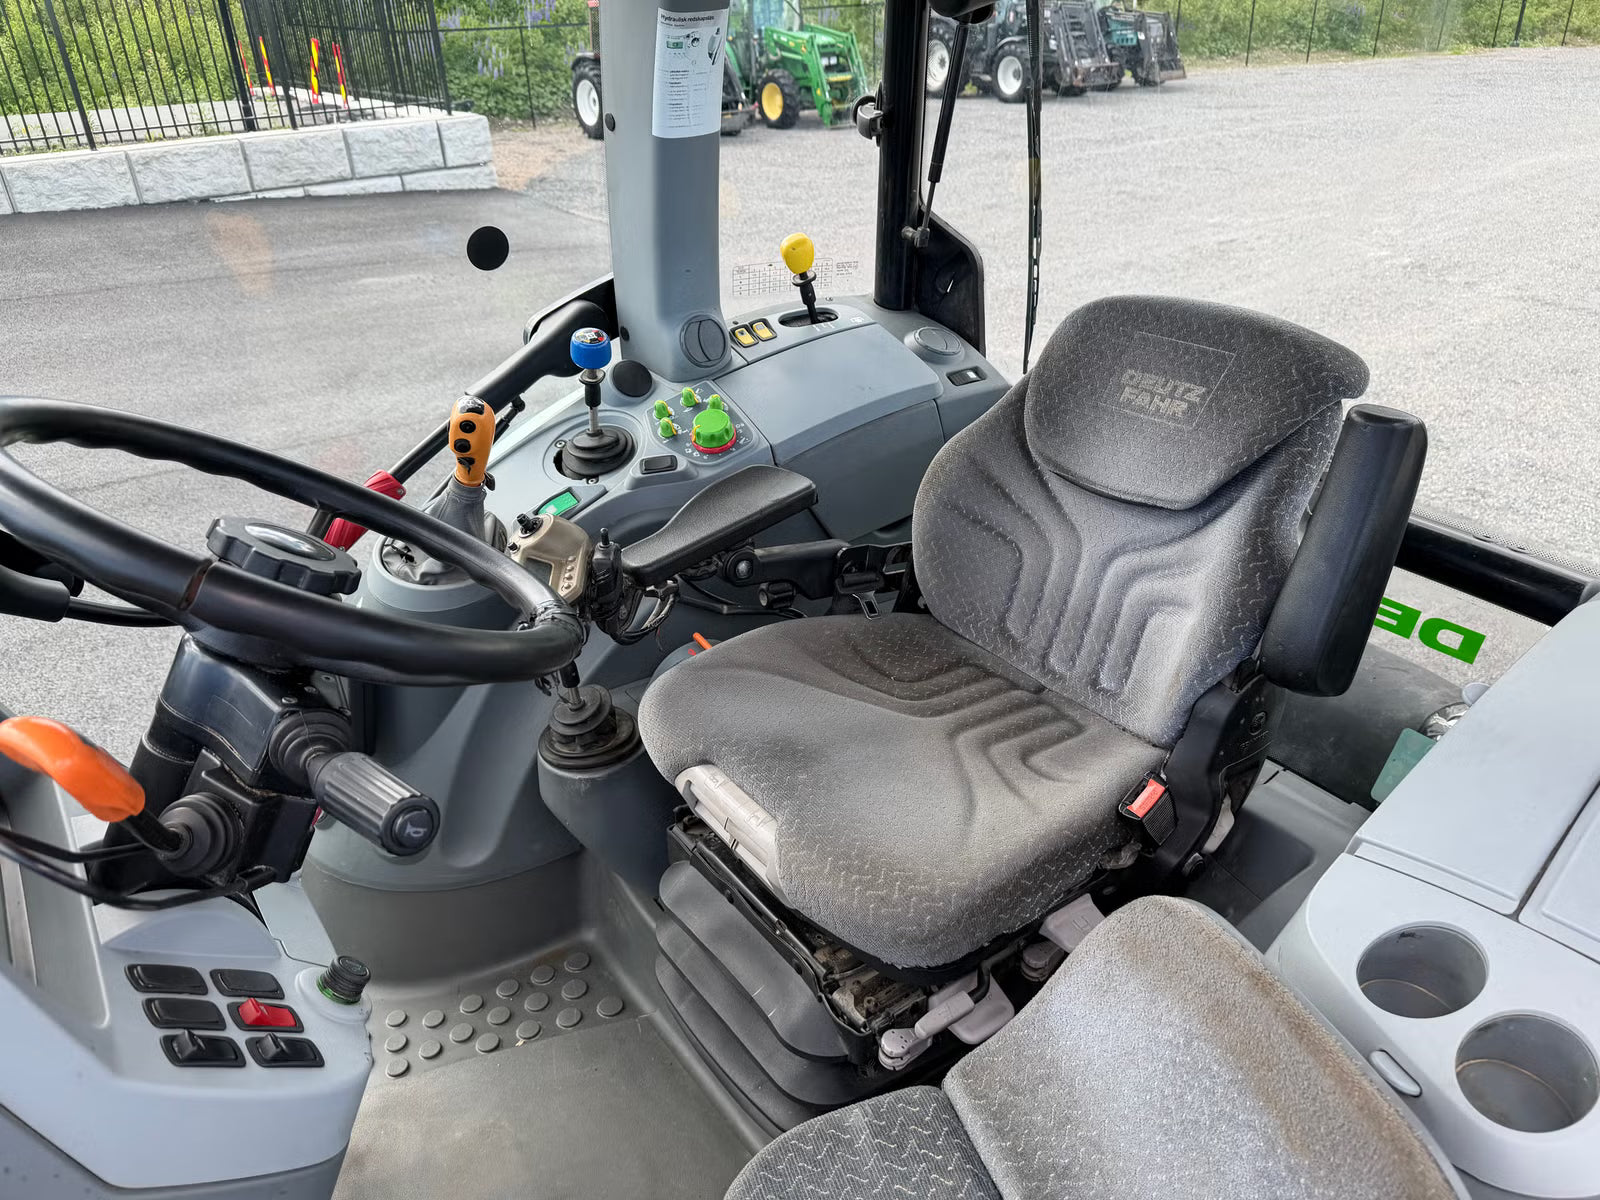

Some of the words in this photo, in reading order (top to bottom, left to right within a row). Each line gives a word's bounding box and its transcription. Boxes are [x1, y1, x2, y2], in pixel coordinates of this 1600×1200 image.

[660, 13, 687, 23] Hydraulisk
[1120, 368, 1207, 402] DEUTZ
[1119, 386, 1188, 419] FAHR
